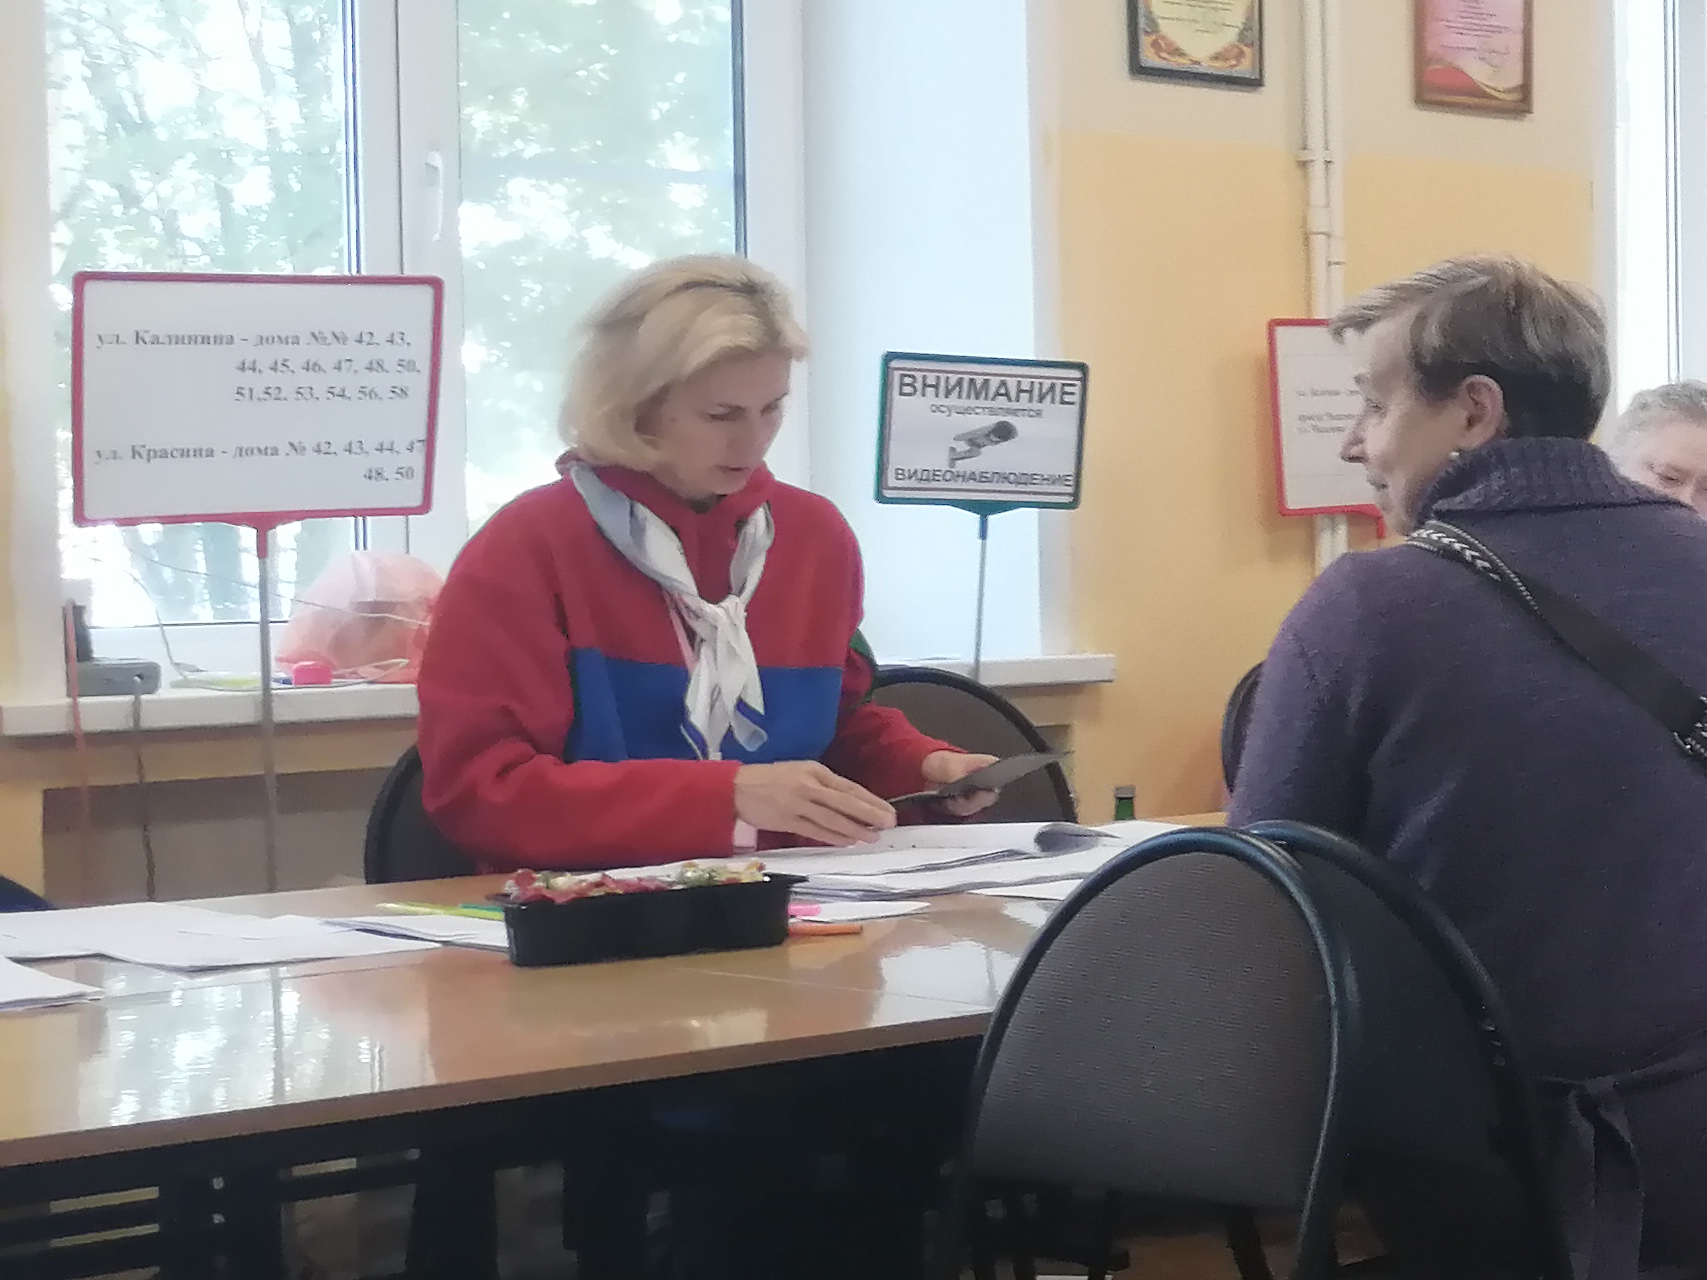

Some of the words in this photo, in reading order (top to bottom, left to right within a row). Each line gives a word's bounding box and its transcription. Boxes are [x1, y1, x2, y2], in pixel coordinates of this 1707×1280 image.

[134, 329, 236, 346] Калинина
[253, 334, 301, 347] дома
[898, 373, 1078, 406] ВНИМАНИЕ
[130, 444, 216, 464] Красина
[233, 445, 280, 458] дома
[894, 467, 1075, 488] ВИДЕОНАБЛЮДЕНИЕ
